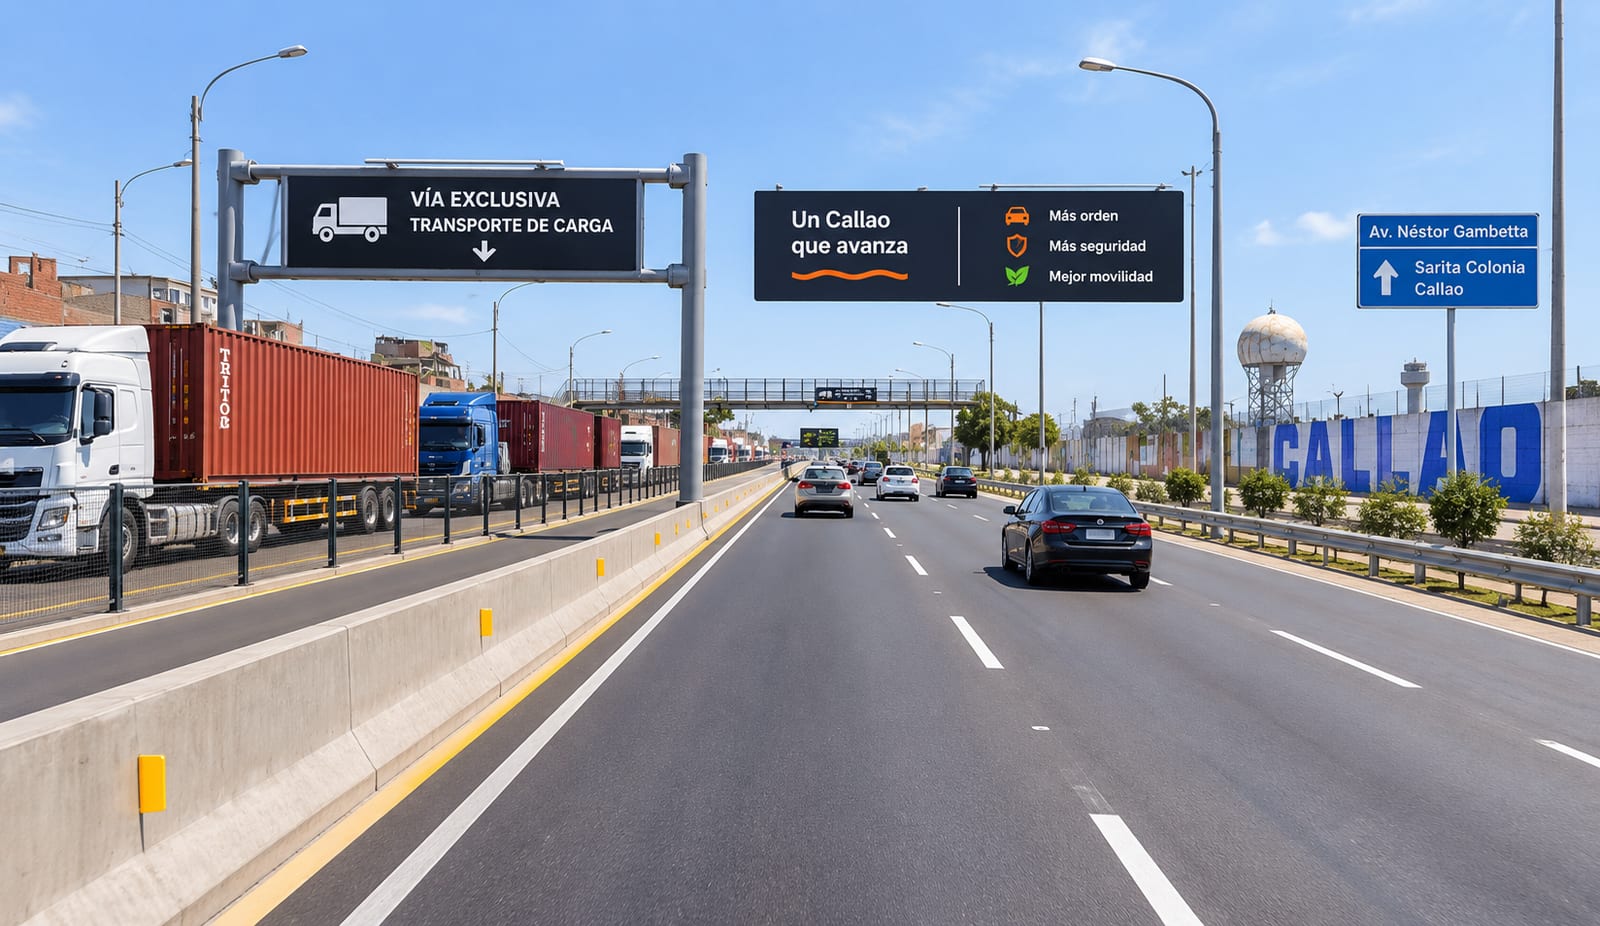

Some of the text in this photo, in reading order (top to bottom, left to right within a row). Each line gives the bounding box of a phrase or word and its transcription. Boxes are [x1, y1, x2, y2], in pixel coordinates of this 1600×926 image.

[410, 187, 561, 208] VÍA EXCLUSIVA
[792, 210, 891, 229] Un Callao
[1050, 209, 1119, 222] Más orden
[410, 218, 613, 233] TRANSPORTE DE CARGA
[1369, 224, 1529, 239] Av. Néstor Gambetta
[791, 241, 909, 259] que avanza
[1050, 239, 1147, 256] Más seguridad
[1415, 260, 1525, 274] Sarita Colonia
[1050, 269, 1153, 285] Mejor movilidad
[1415, 282, 1464, 296] Callao
[1273, 403, 1541, 503] CALLAO
